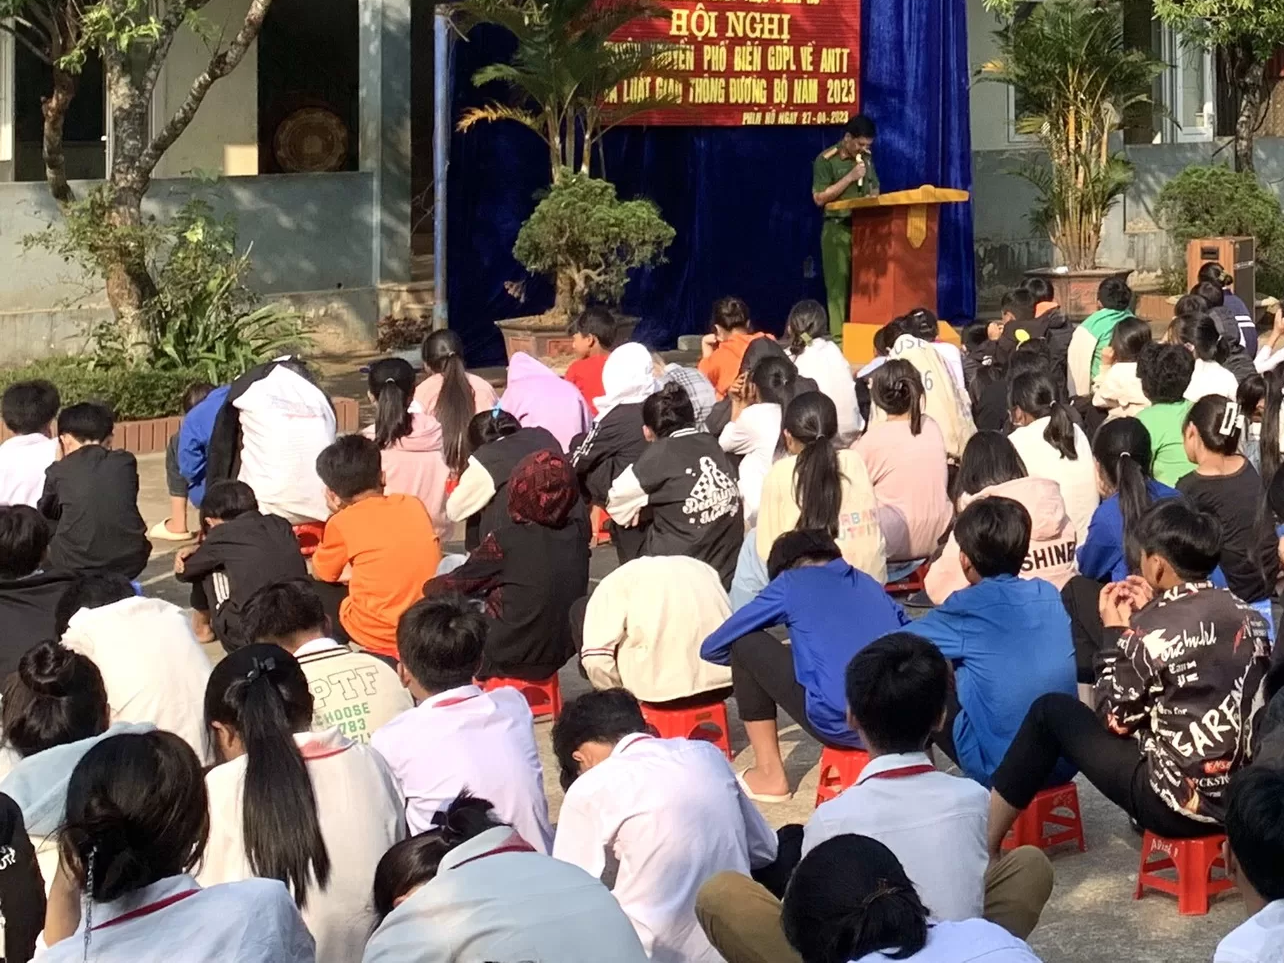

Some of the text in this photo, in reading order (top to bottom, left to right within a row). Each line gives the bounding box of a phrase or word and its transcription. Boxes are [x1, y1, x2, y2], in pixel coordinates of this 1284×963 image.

[669, 2, 718, 41] HỘI
[768, 46, 796, 71] GDPL
[820, 48, 850, 73] ANTT
[689, 73, 725, 104] THÔNG
[793, 75, 818, 104] NĂM
[827, 79, 855, 104] 2023
